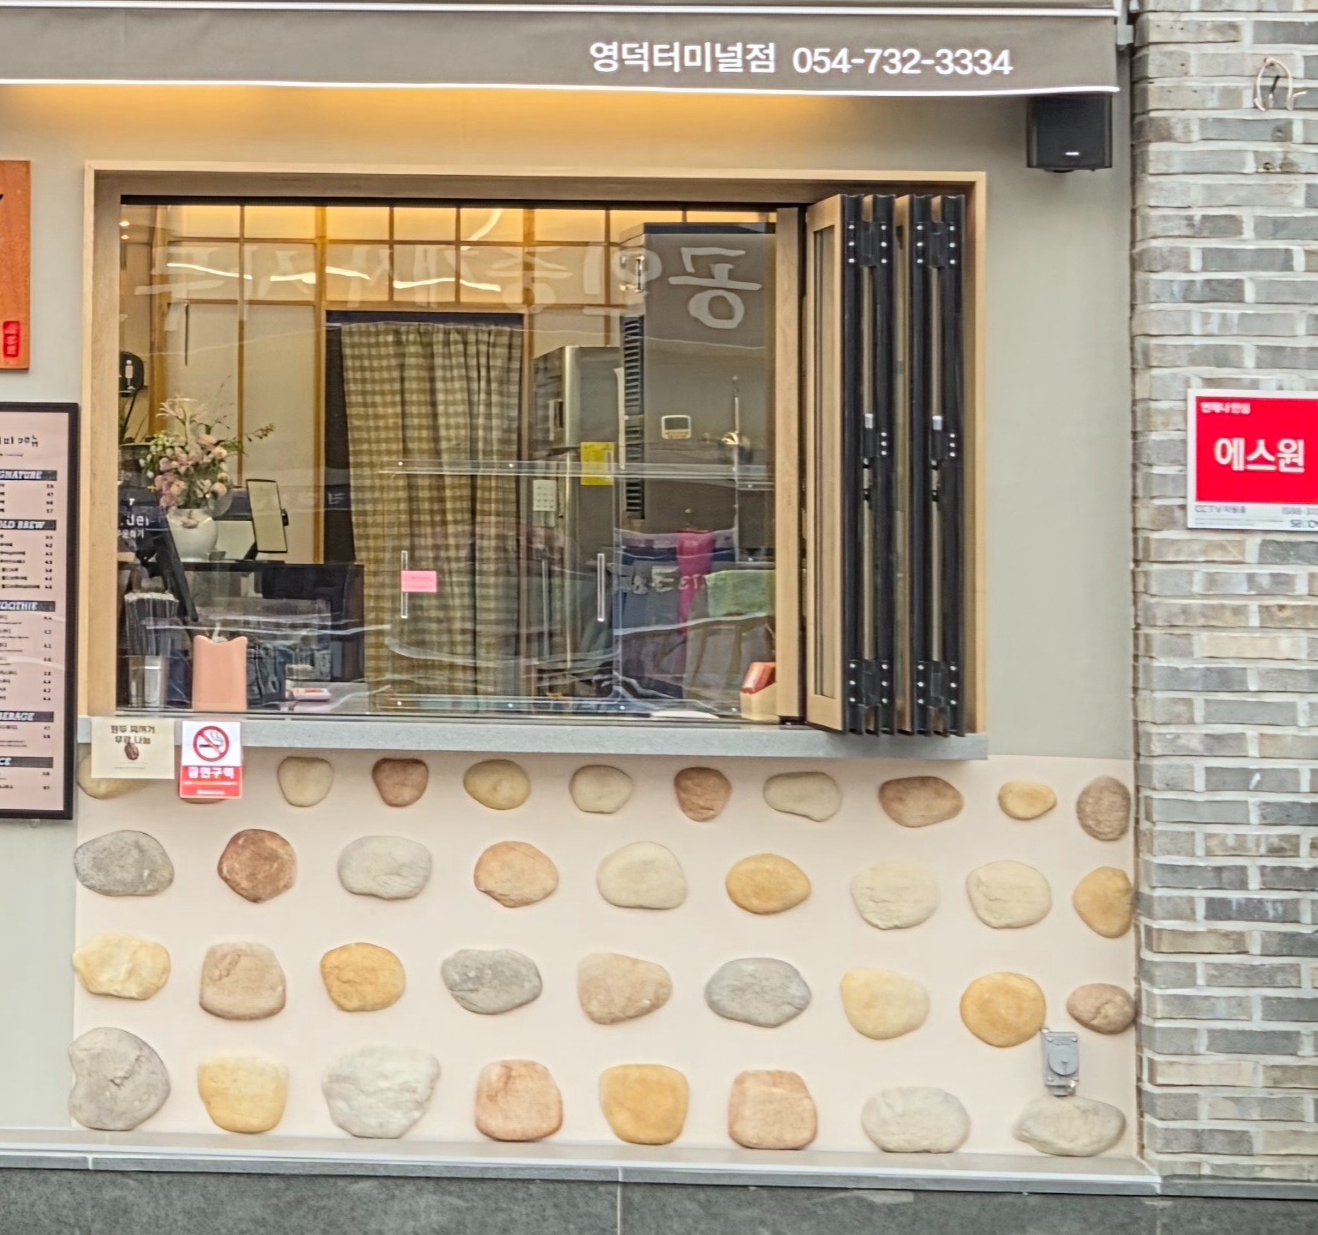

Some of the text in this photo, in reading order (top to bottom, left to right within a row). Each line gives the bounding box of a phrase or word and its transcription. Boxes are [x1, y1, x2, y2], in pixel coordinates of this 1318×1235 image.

[588, 41, 1014, 77] 영덕터미널점 054-732-3334
[1214, 437, 1306, 474] 에스원
[188, 766, 234, 779] 금연구역
